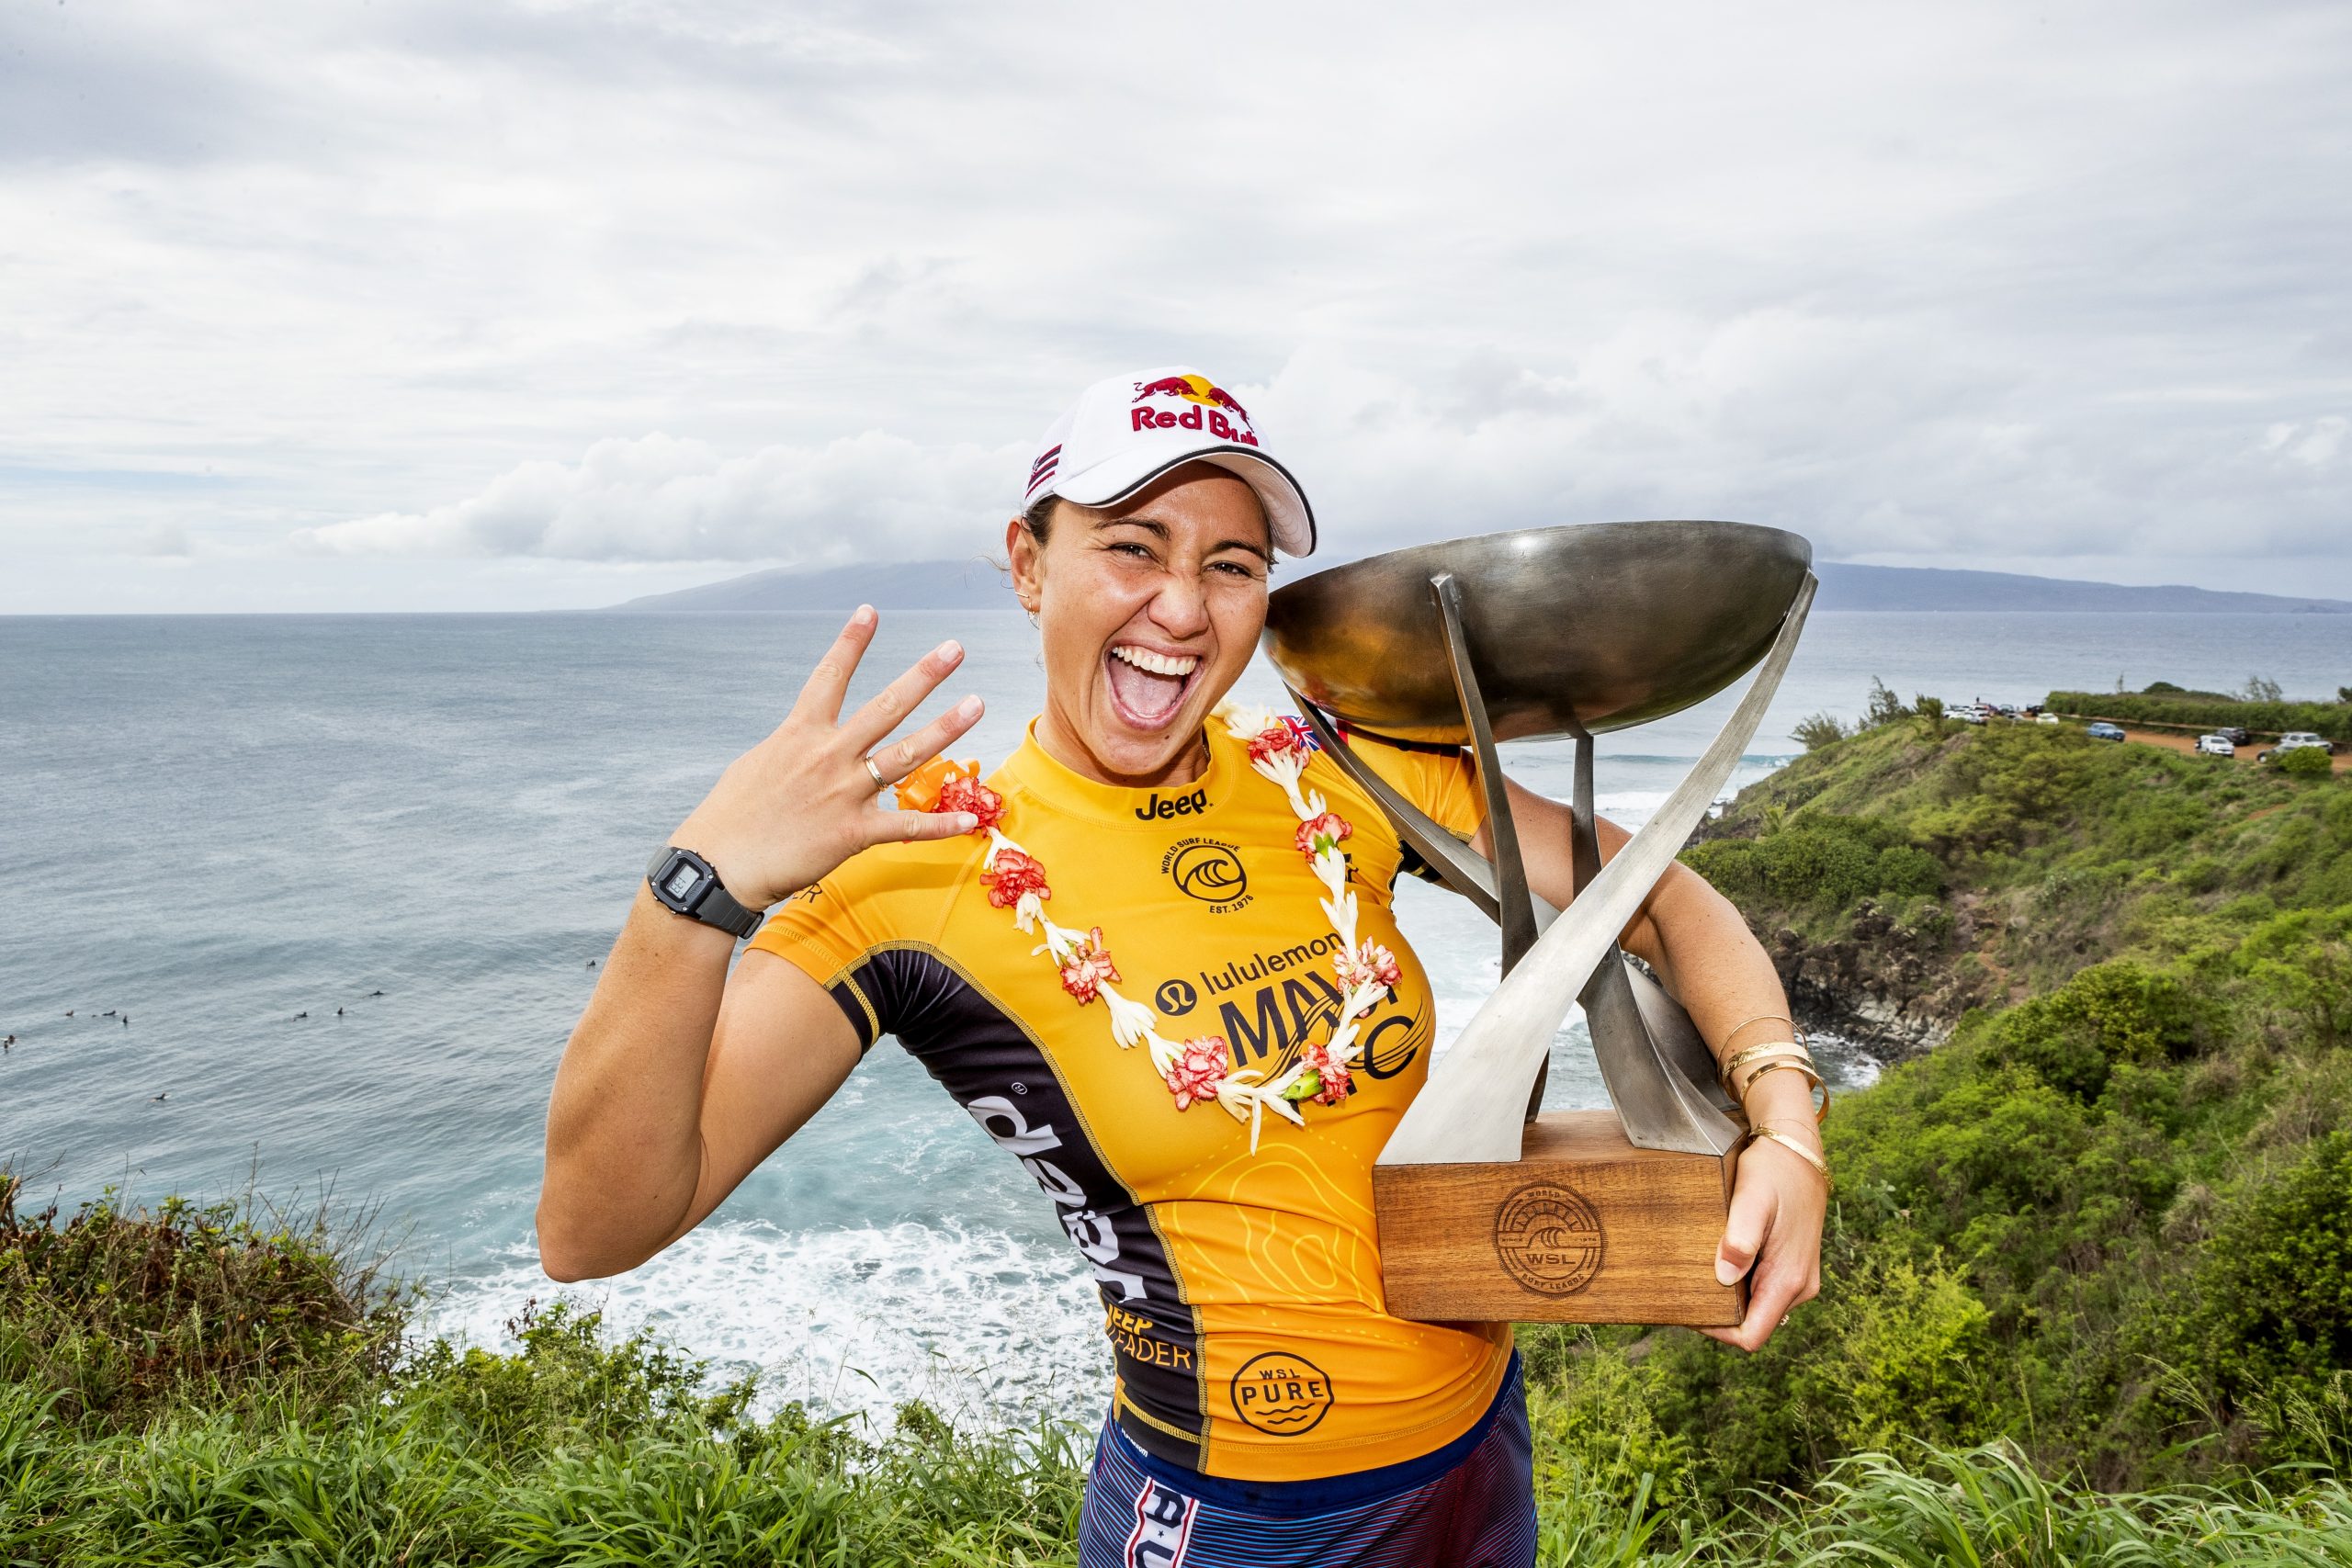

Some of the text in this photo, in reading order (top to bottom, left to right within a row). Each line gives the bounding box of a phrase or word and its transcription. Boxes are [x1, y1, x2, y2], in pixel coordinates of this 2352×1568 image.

[1131, 404, 1203, 432] Red
[1136, 788, 1207, 821] Jeep
[1160, 837, 1241, 874] WORLD SURF LEAGUE
[1209, 905, 1231, 915] EST.
[1200, 932, 1345, 996] lululemon
[1526, 1253, 1576, 1265] WSL
[1259, 1368, 1301, 1381] WSL
[1241, 1381, 1324, 1405] PURE
